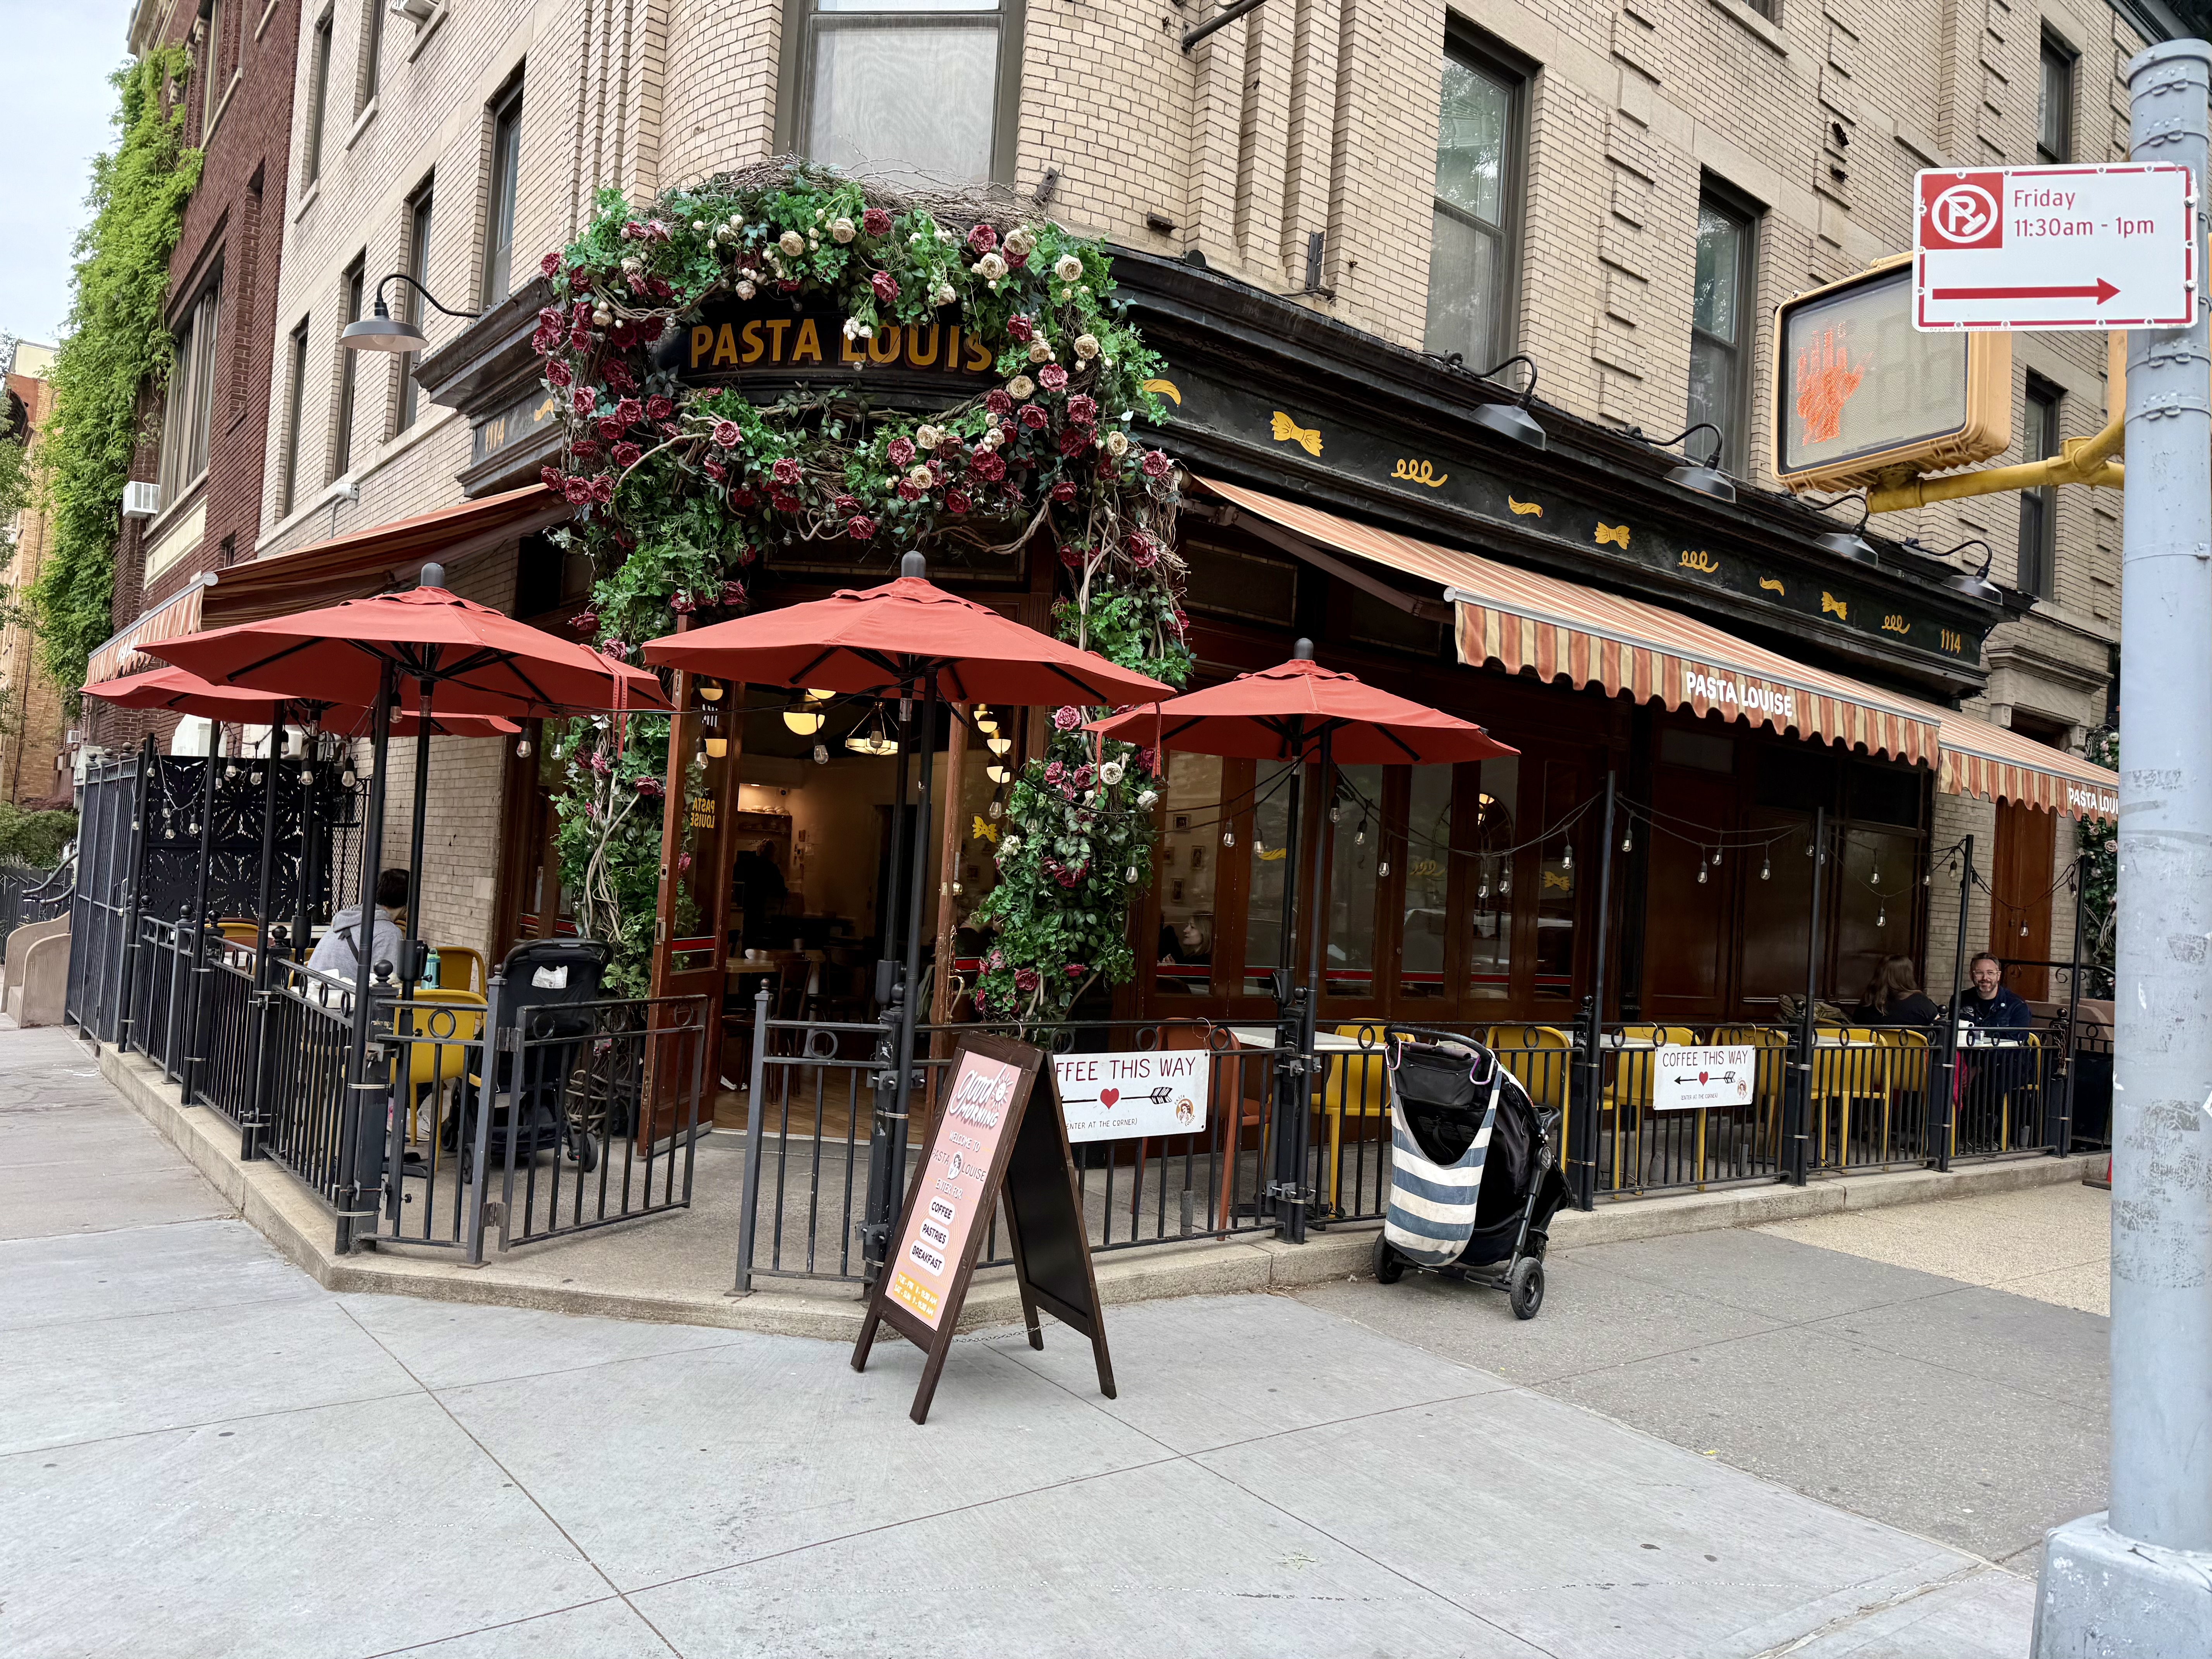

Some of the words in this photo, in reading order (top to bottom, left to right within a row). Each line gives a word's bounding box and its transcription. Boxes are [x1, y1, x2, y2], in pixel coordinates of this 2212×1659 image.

[2014, 189, 2075, 210] Friday
[2014, 218, 2093, 237] 11:30am
[2116, 216, 2154, 238] 1pm
[691, 319, 822, 368] PASTA
[842, 320, 997, 371] LOUIS
[485, 417, 505, 453] 1114
[1941, 629, 1961, 654] 1114
[1686, 671, 1738, 704] PASTA
[1740, 684, 1793, 716] LOUISE
[2068, 787, 2097, 810] PASTA
[2099, 795, 2118, 814] LOUI
[1055, 1061, 1098, 1082] FFEE
[1109, 1058, 1150, 1080] THIS
[1160, 1057, 1196, 1077] WAY
[1663, 1052, 1698, 1067] COFFEE
[1703, 1051, 1724, 1065] THIS
[1729, 1050, 1748, 1065] WAY
[957, 1103, 999, 1127] MORNING
[1066, 1121, 1085, 1130] ENTER
[1112, 1117, 1137, 1126] CORNER)
[949, 1130, 972, 1149] WELCOME
[972, 1140, 981, 1152] TO
[931, 1148, 950, 1165] PASTA
[962, 1162, 986, 1182] LOUISE
[935, 1178, 952, 1195] ENTER
[951, 1186, 963, 1200] FOR
[931, 1202, 952, 1219] COFFEE
[922, 1224, 946, 1244] PASTRIES
[912, 1245, 943, 1270] BREAKFAST
